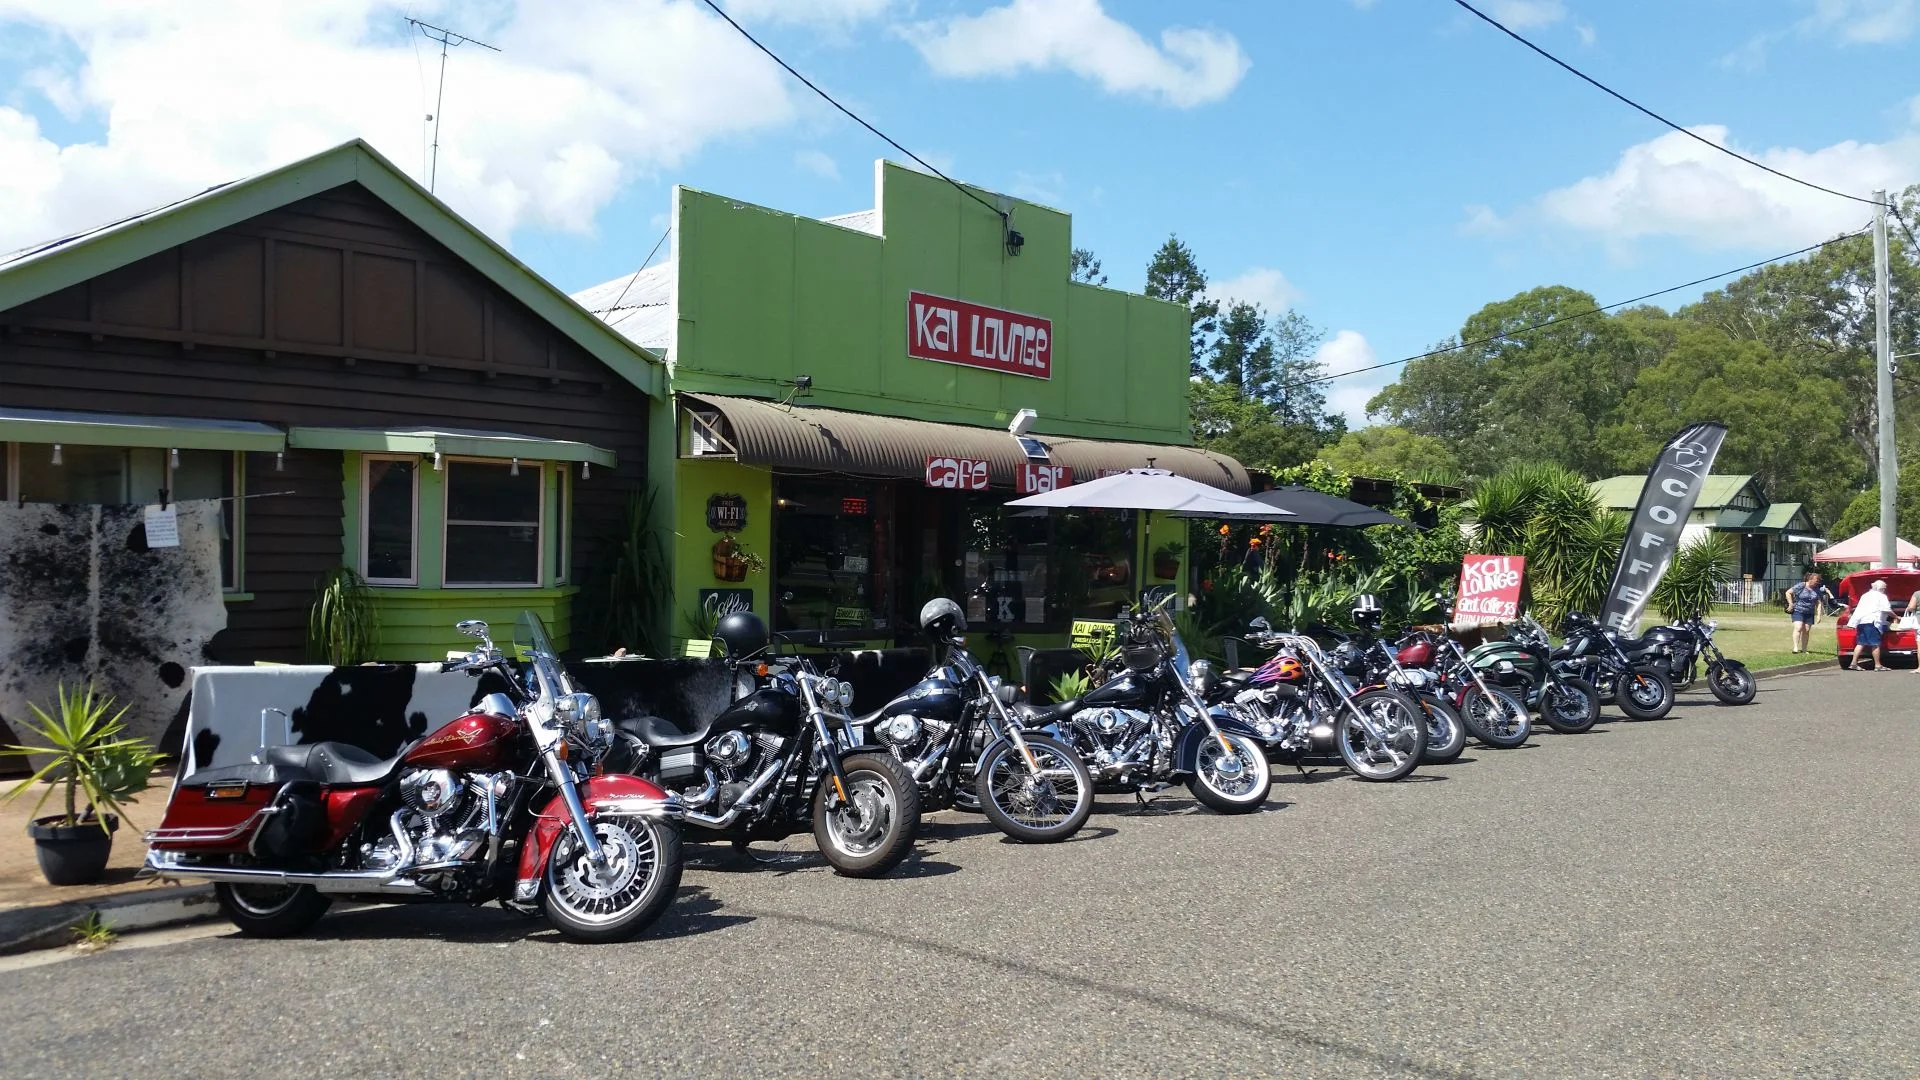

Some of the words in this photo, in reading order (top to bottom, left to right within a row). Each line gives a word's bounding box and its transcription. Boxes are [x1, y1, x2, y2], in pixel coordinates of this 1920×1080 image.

[1026, 465, 1063, 494] bar
[717, 507, 739, 519] WI-FI
[1607, 478, 1689, 633] COFFEE
[1073, 622, 1087, 634] KAI
